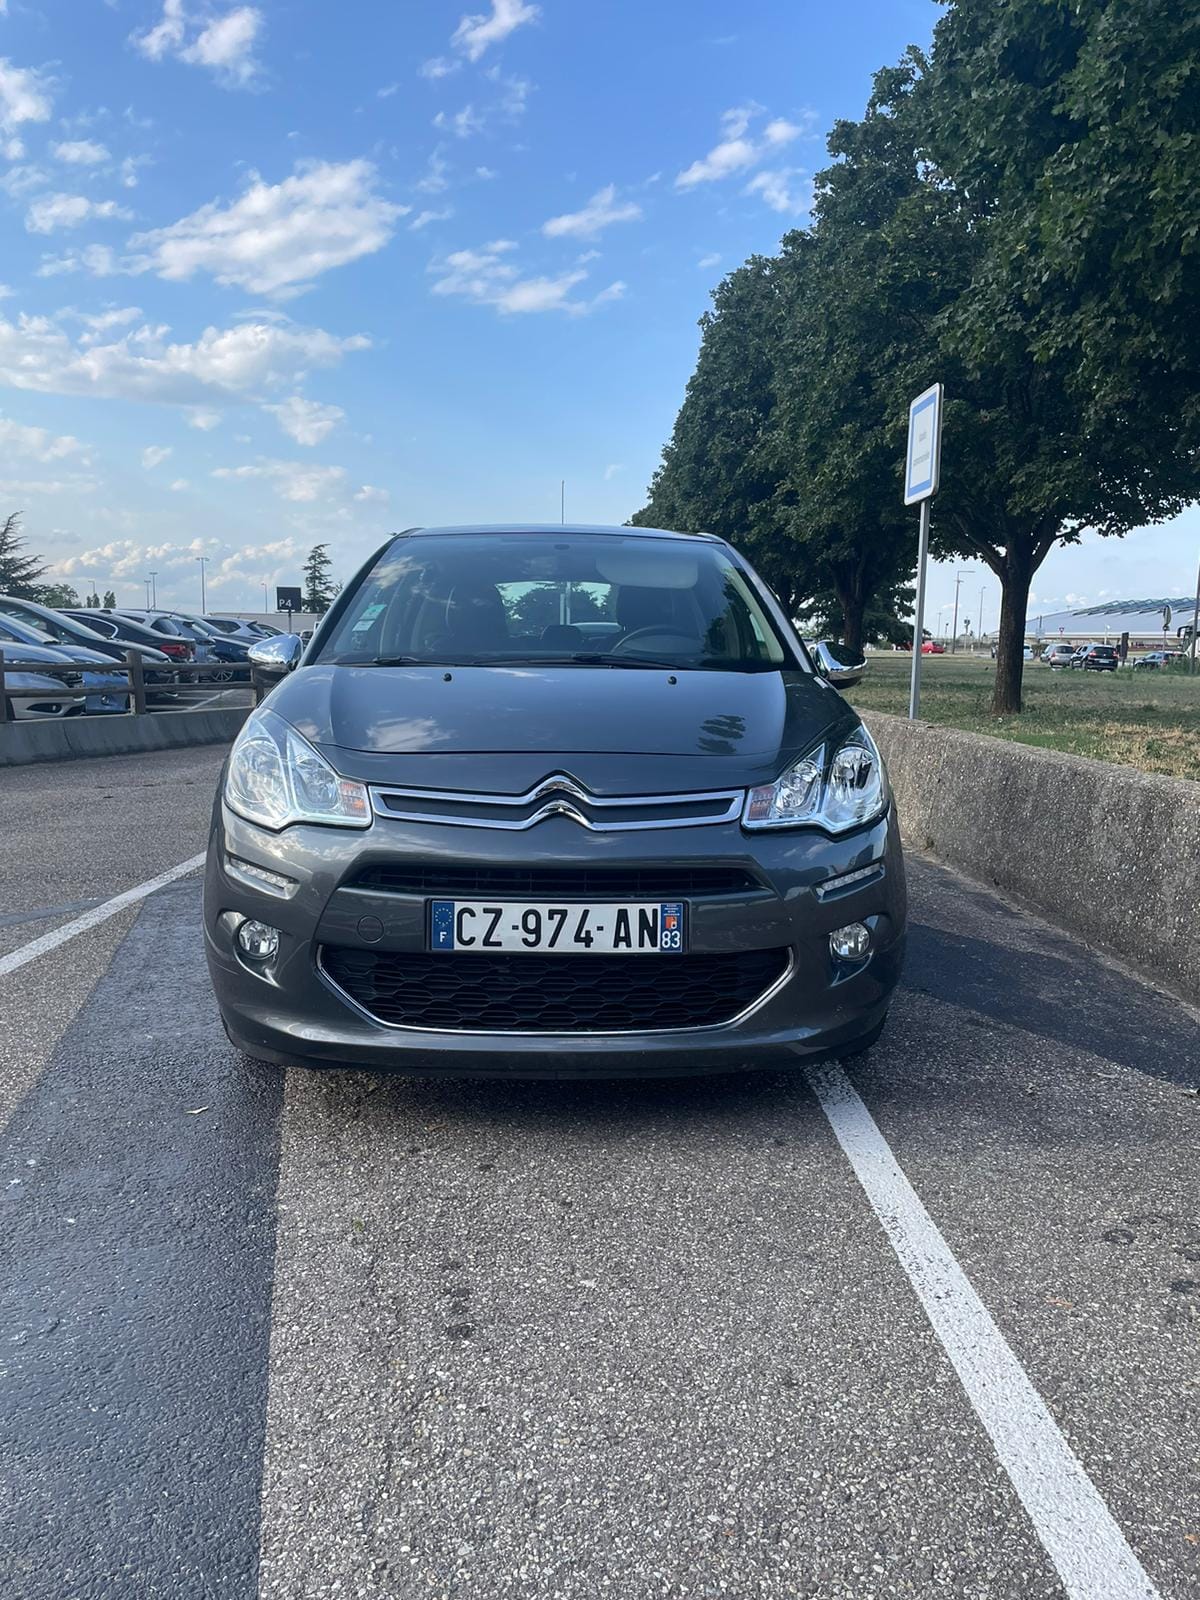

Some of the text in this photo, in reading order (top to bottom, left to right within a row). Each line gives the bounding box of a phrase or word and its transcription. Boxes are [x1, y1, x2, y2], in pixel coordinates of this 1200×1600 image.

[279, 599, 292, 608] P4
[456, 907, 659, 948] CZ-974-AN
[439, 931, 447, 943] F
[661, 931, 681, 949] 83
